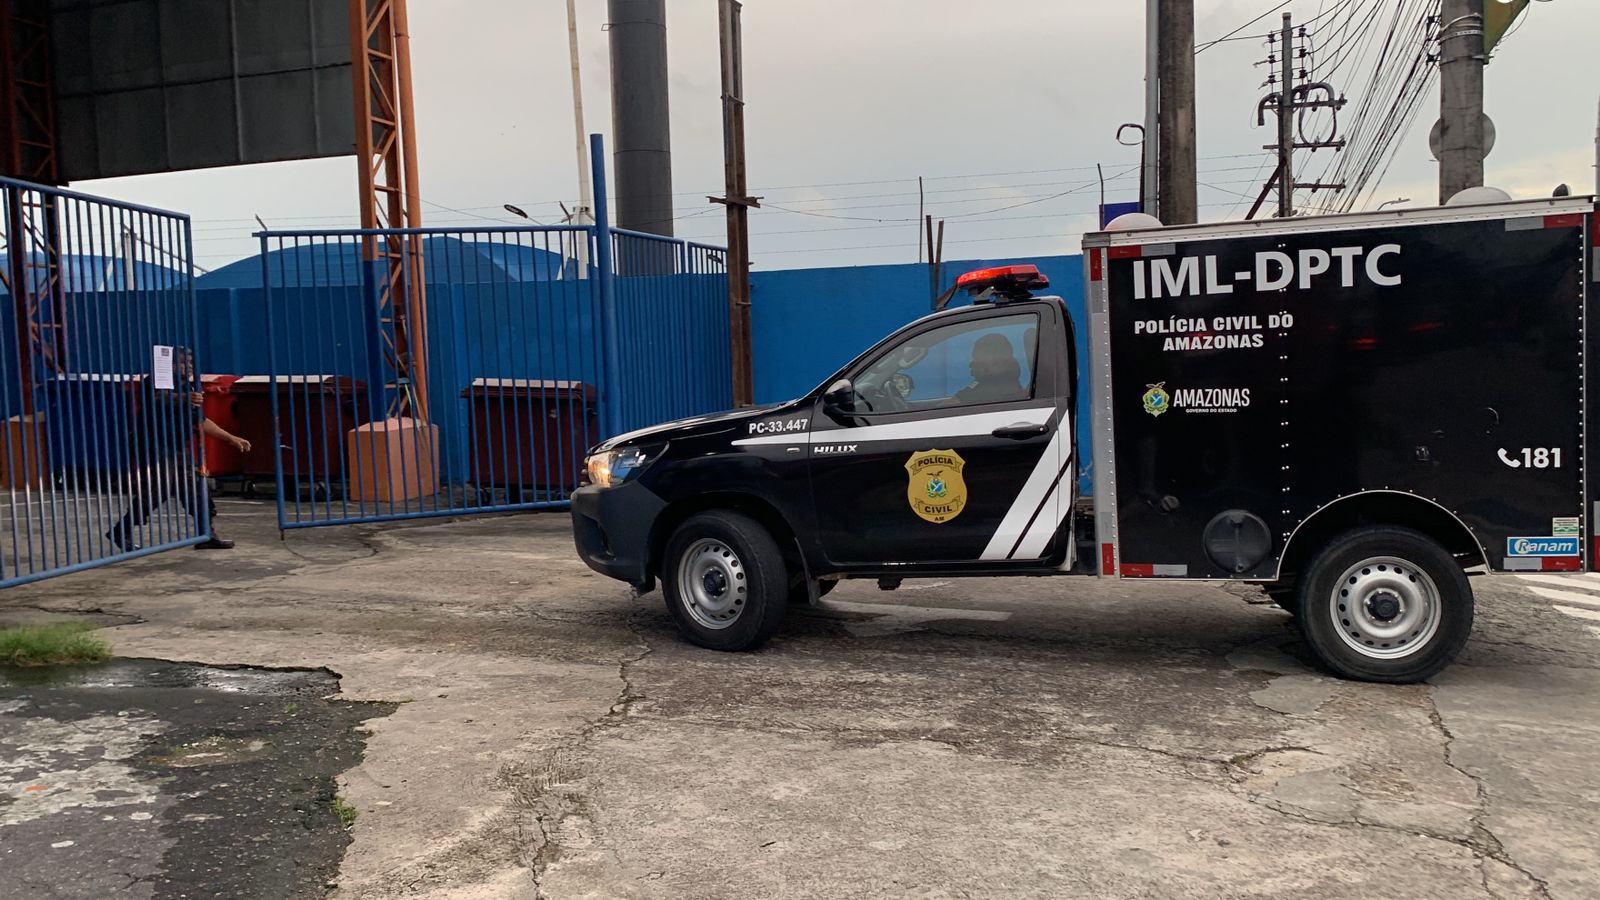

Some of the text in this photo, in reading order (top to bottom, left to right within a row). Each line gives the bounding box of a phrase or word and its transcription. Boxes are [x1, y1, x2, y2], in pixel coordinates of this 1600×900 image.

[1133, 243, 1401, 299] IML-DPTC
[1134, 314, 1294, 334] POLÍCIA CIVIL DO
[1162, 333, 1264, 351] AMAZONAS
[1173, 388, 1250, 407] AMAZONAS
[748, 419, 808, 434] PC-33.447
[814, 444, 858, 454] HILUX
[918, 456, 954, 467] POLÍCIA
[1521, 447, 1560, 468] 181
[924, 505, 953, 514] CIVIL
[1516, 540, 1574, 552] Ranam
